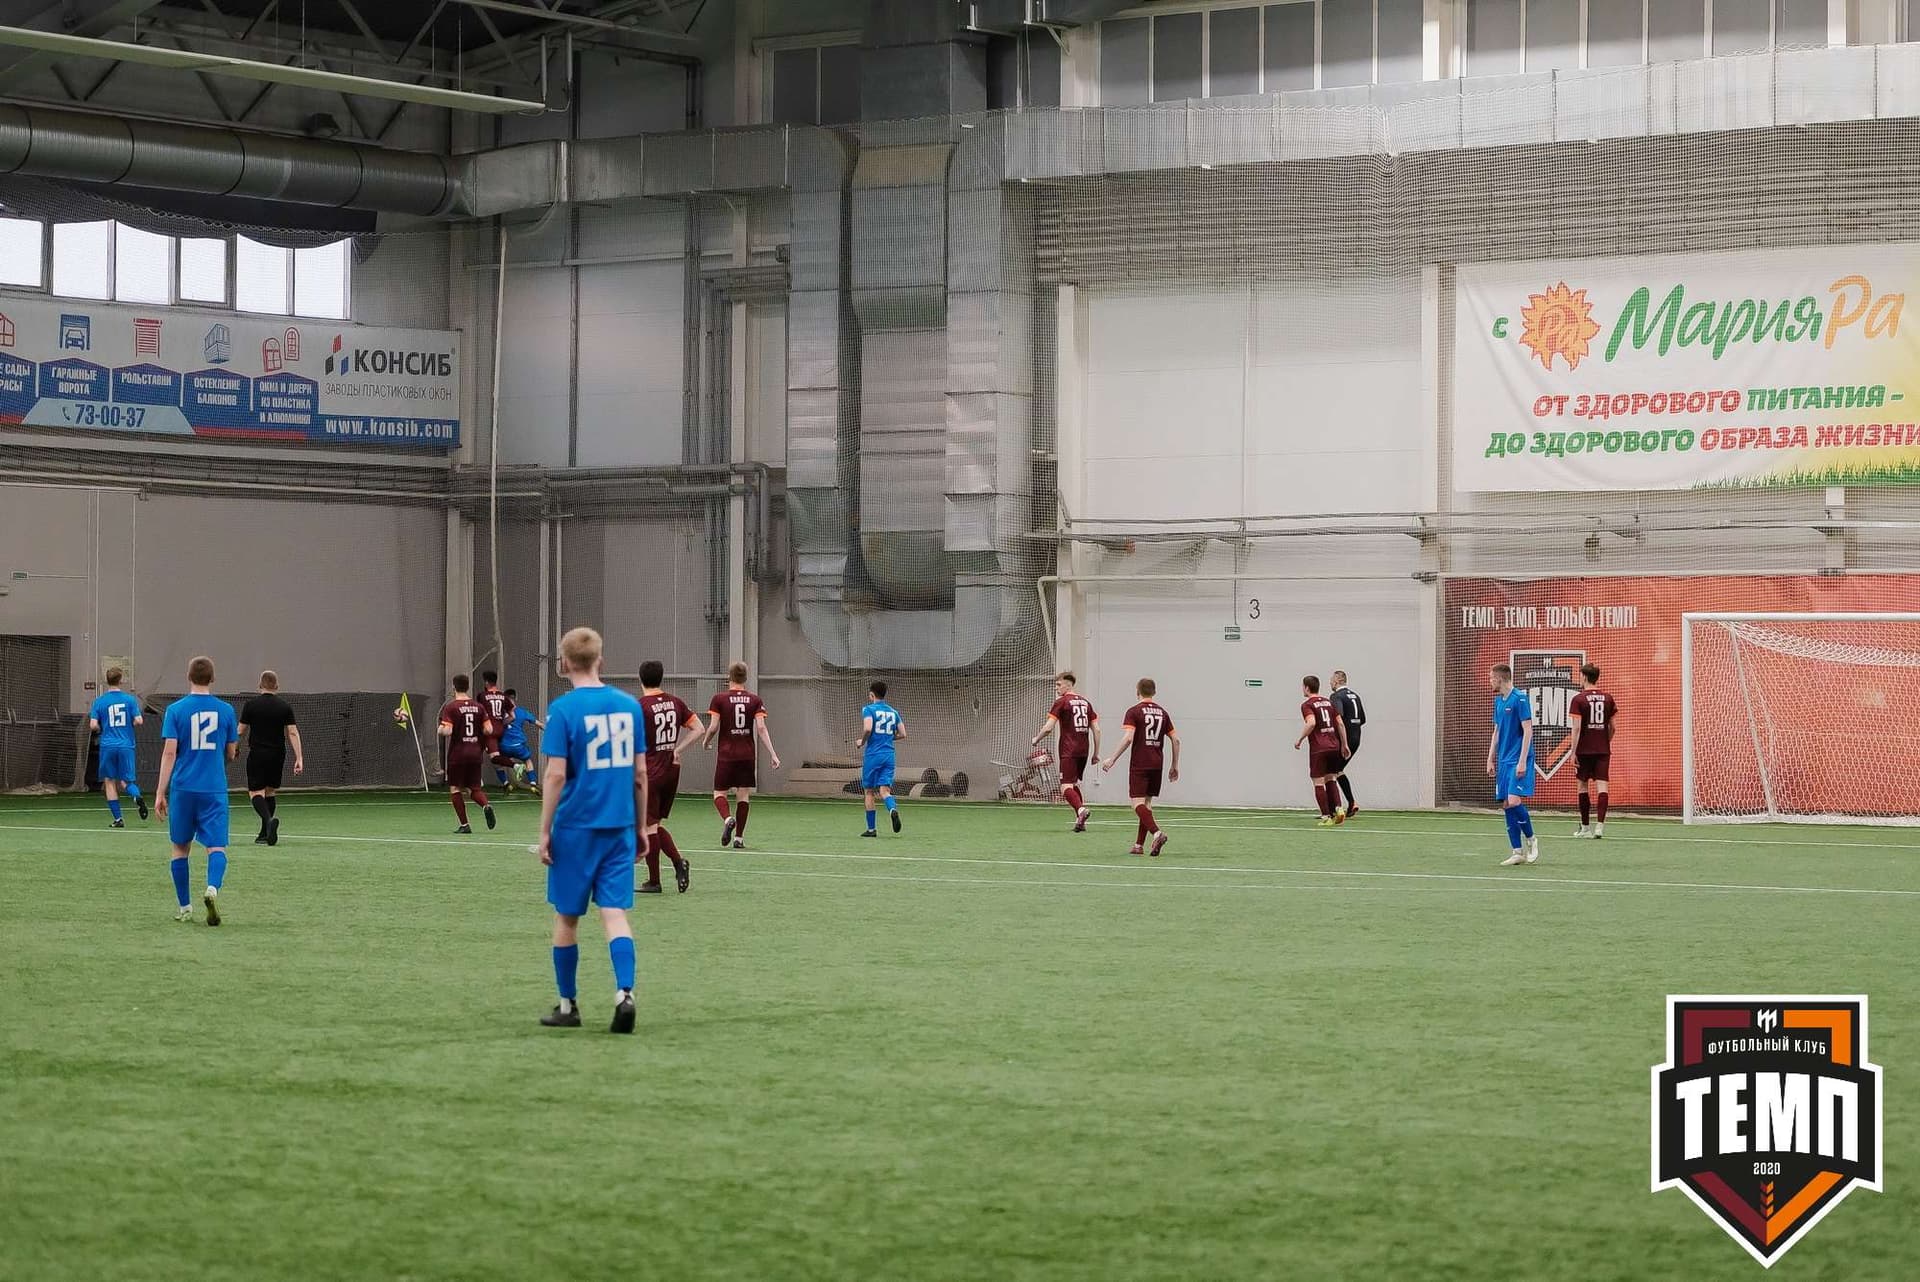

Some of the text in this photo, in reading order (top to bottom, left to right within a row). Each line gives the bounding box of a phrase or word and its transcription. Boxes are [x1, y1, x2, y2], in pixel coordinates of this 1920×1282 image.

[51, 366, 98, 381] ГАРАЖНЫЕ
[354, 349, 452, 377] КОНСИБ
[58, 382, 90, 395] ВОРОТА
[121, 372, 172, 386] РОЛЬСТАВНИ
[194, 377, 241, 391] ОСТЕКЛЕНИЕ
[260, 381, 279, 393] ОКНА
[288, 383, 312, 395] ДВЕРИ
[197, 393, 238, 406] БАЛКОНОВ
[272, 397, 311, 409] ПЛАСТИКА
[325, 383, 452, 401] ЗАВОДЫ ПЛАСТИКОВЫХ ОКОН
[1532, 395, 1570, 418] ОТ
[1573, 389, 1742, 420] ЗДОРОВОГО
[1747, 384, 1886, 413] ПИТАНИЯ
[75, 404, 146, 428] 73-00-37
[325, 419, 453, 439] www.konsib.com
[1485, 430, 1526, 458] ДО
[1530, 428, 1695, 458] ЗДОРОВОГО
[1700, 425, 1808, 451] ОБРАЗА
[1249, 598, 1261, 619] 3
[1462, 606, 1638, 630] ТЕМП, ТЕМП, ТОЛЬКО ТЕМП!
[108, 703, 127, 727] 15
[490, 699, 502, 717] 10
[734, 704, 746, 729] 6
[1073, 705, 1089, 728] 25
[1320, 707, 1331, 727] 4
[1351, 698, 1359, 718] 1
[1588, 701, 1605, 724] 18
[190, 711, 218, 750] 12
[465, 714, 474, 736] 5
[654, 710, 678, 744] 23
[875, 710, 897, 735] 22
[1144, 714, 1163, 740] 27
[584, 712, 635, 770] 28
